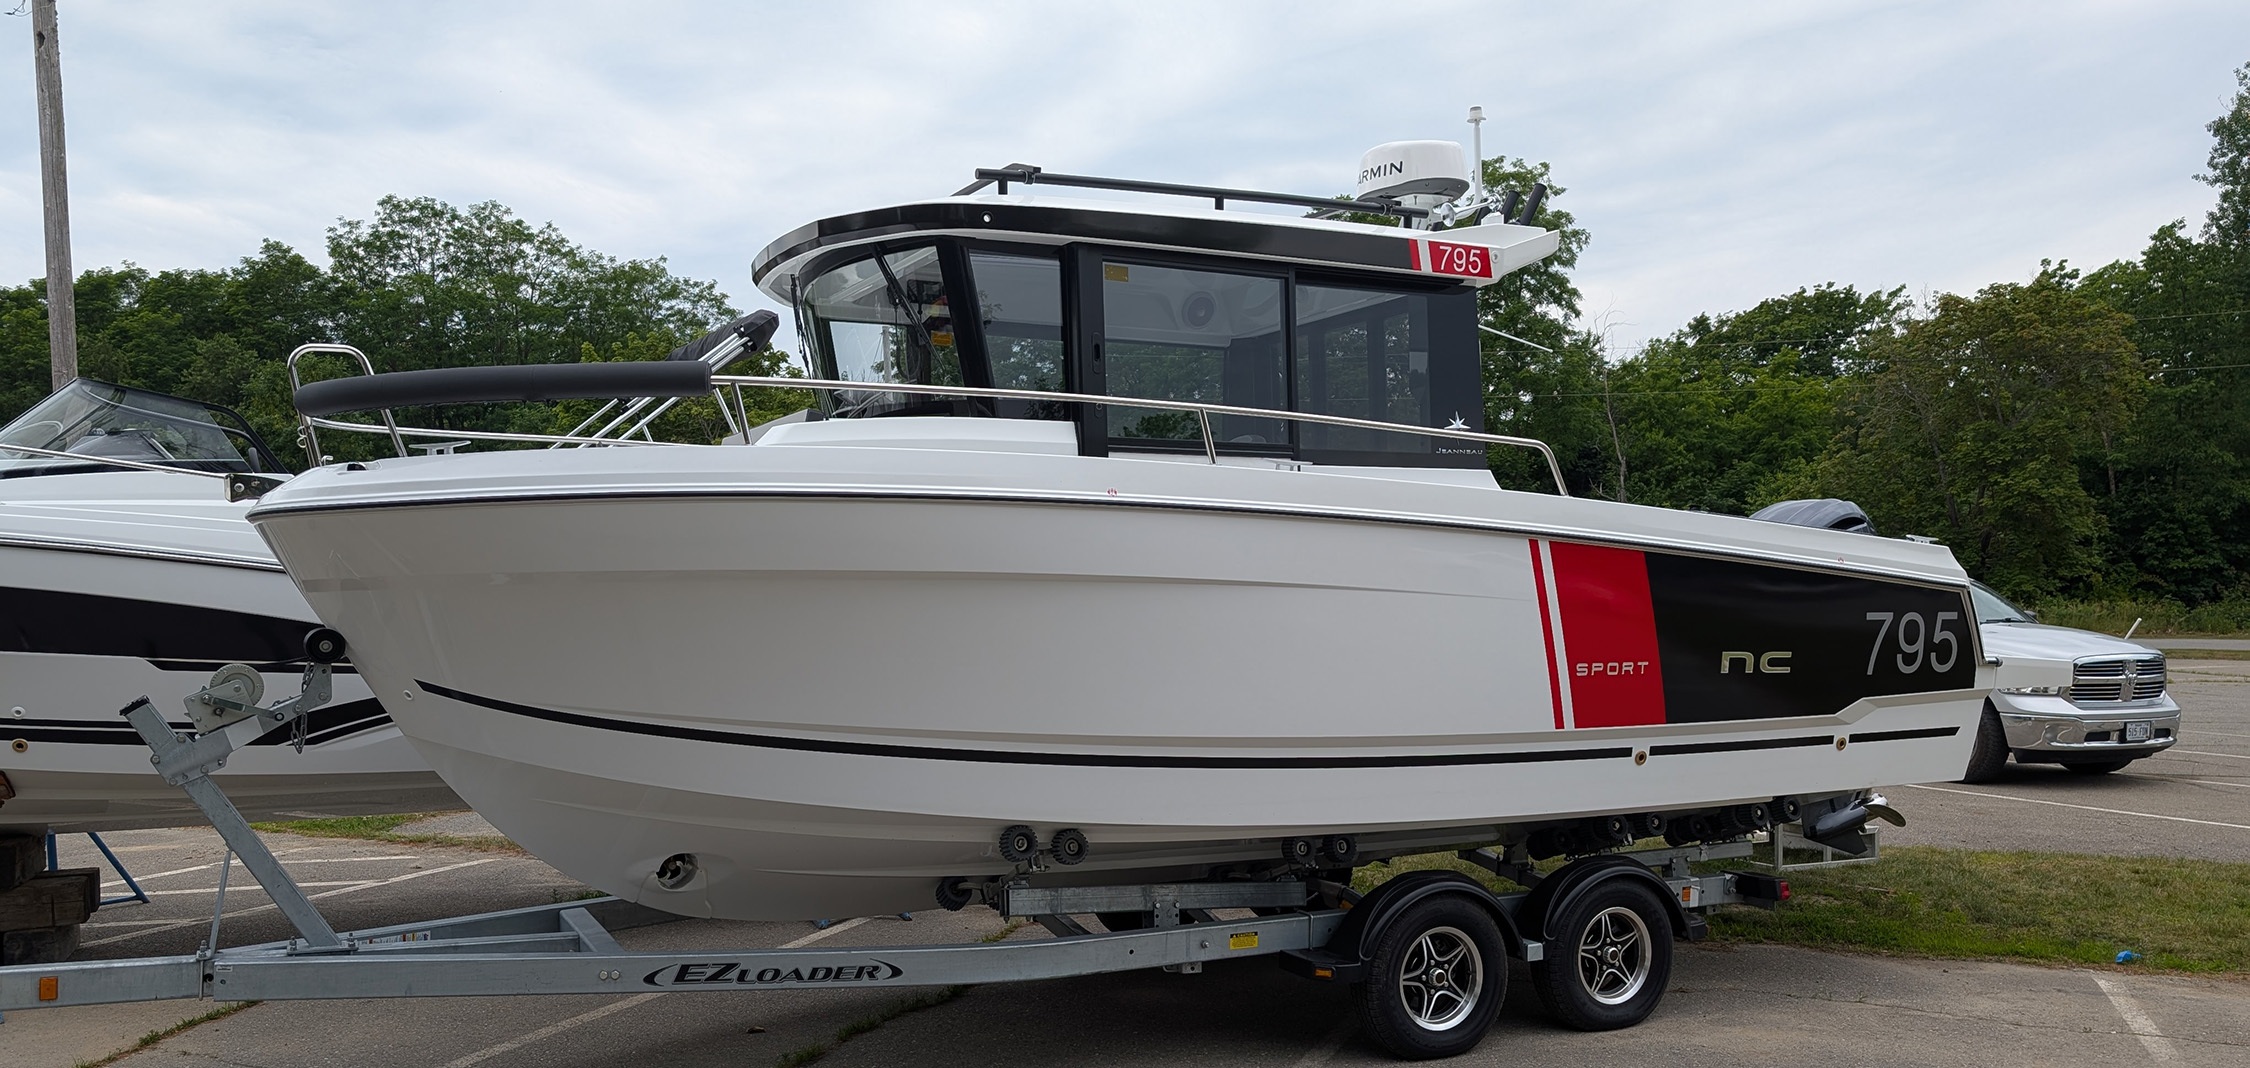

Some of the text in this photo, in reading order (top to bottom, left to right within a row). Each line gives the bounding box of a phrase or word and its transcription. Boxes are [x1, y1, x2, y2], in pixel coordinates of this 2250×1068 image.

[1357, 160, 1404, 186] ARMIN
[1439, 245, 1482, 274] 795
[1435, 447, 1483, 455] JEANNEAU
[1866, 611, 1958, 676] 795
[1575, 661, 1649, 677] SPORT
